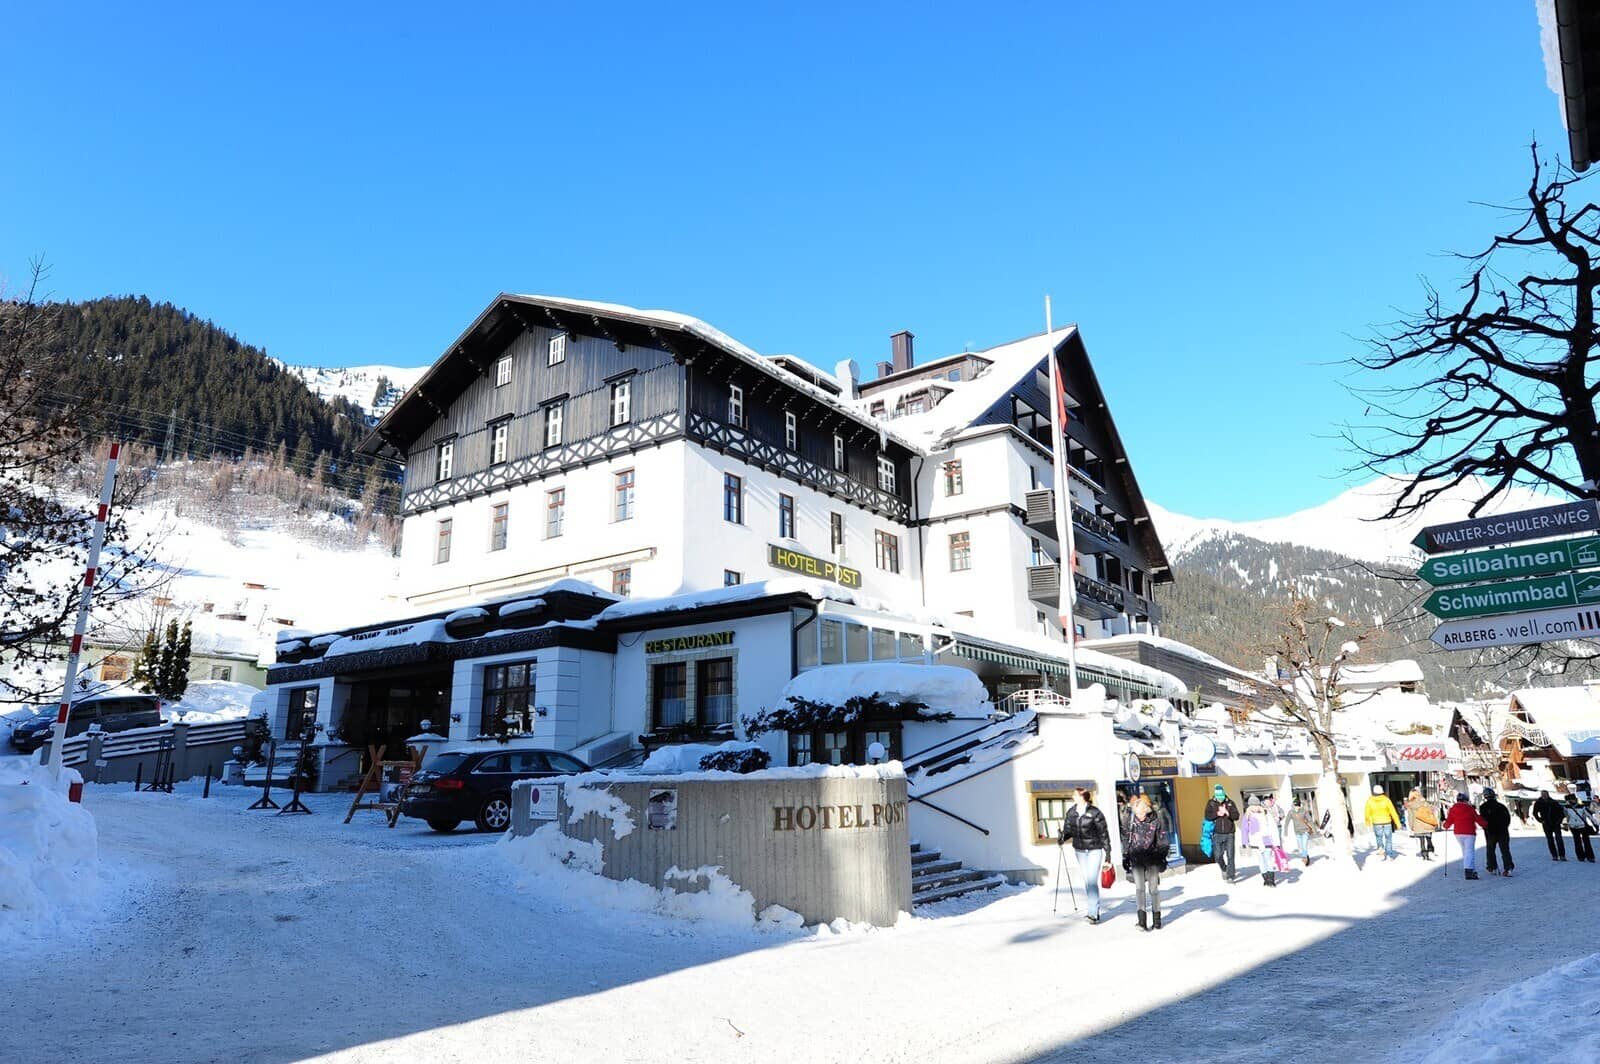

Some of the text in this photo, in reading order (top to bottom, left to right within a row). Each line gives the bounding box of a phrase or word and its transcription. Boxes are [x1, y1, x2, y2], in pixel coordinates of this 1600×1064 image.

[1433, 509, 1590, 545] WALTER-SCHULER-WEG
[777, 549, 858, 586] HOTEL POST
[1433, 550, 1565, 577] Seilbahnen
[1439, 581, 1568, 611] Schwimmbad
[645, 631, 733, 654] RESTAURANT
[1444, 629, 1496, 645] ARLBERG
[1506, 619, 1577, 638] well.com
[1400, 746, 1447, 761] Alber
[773, 801, 906, 831] HOTEL POST
